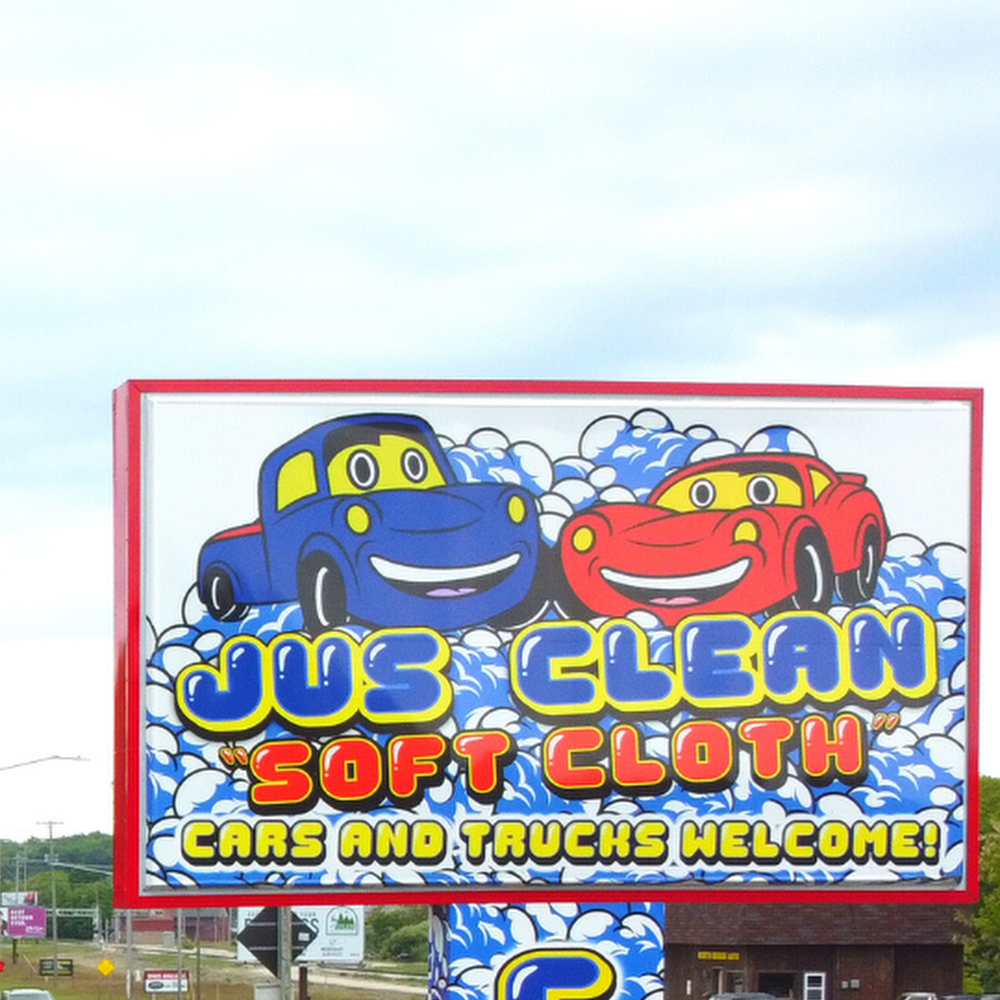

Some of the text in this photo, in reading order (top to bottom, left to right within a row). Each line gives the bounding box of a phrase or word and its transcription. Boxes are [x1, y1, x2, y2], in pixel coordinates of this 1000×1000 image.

[177, 605, 937, 733] JUS CLEAN
[182, 819, 940, 866] CARS AND TRUCKS WELCOME!
